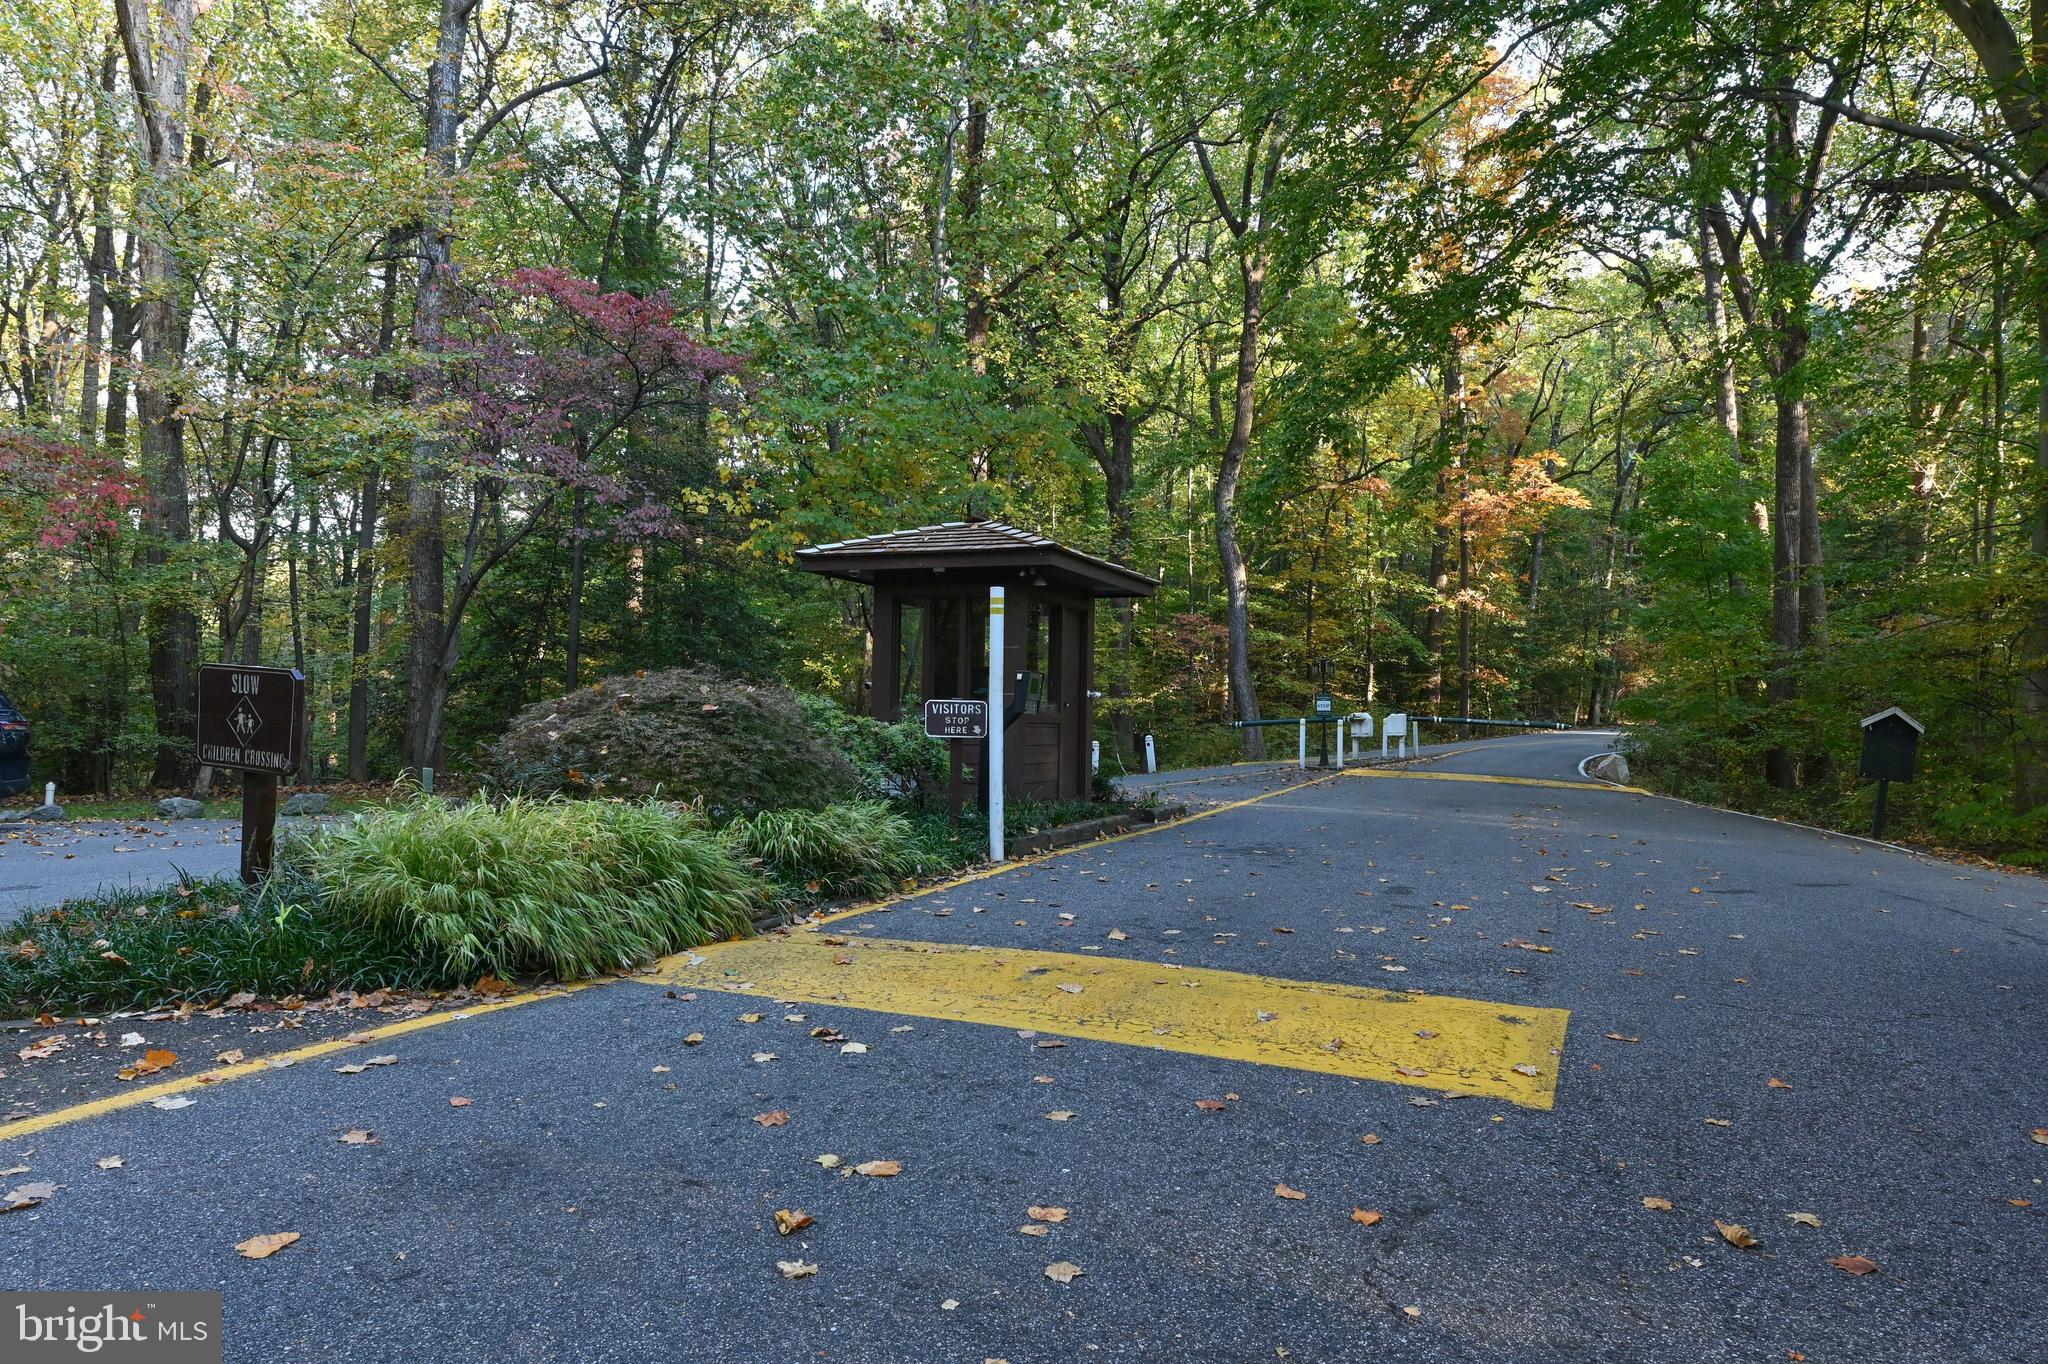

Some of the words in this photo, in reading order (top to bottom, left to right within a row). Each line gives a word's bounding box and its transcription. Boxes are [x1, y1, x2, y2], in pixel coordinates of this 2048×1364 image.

[231, 673, 260, 695] SLOW
[932, 703, 982, 715] VISITORS
[944, 716, 970, 725] STOP
[944, 726, 968, 734] HERE
[202, 743, 241, 763] CHILDREN
